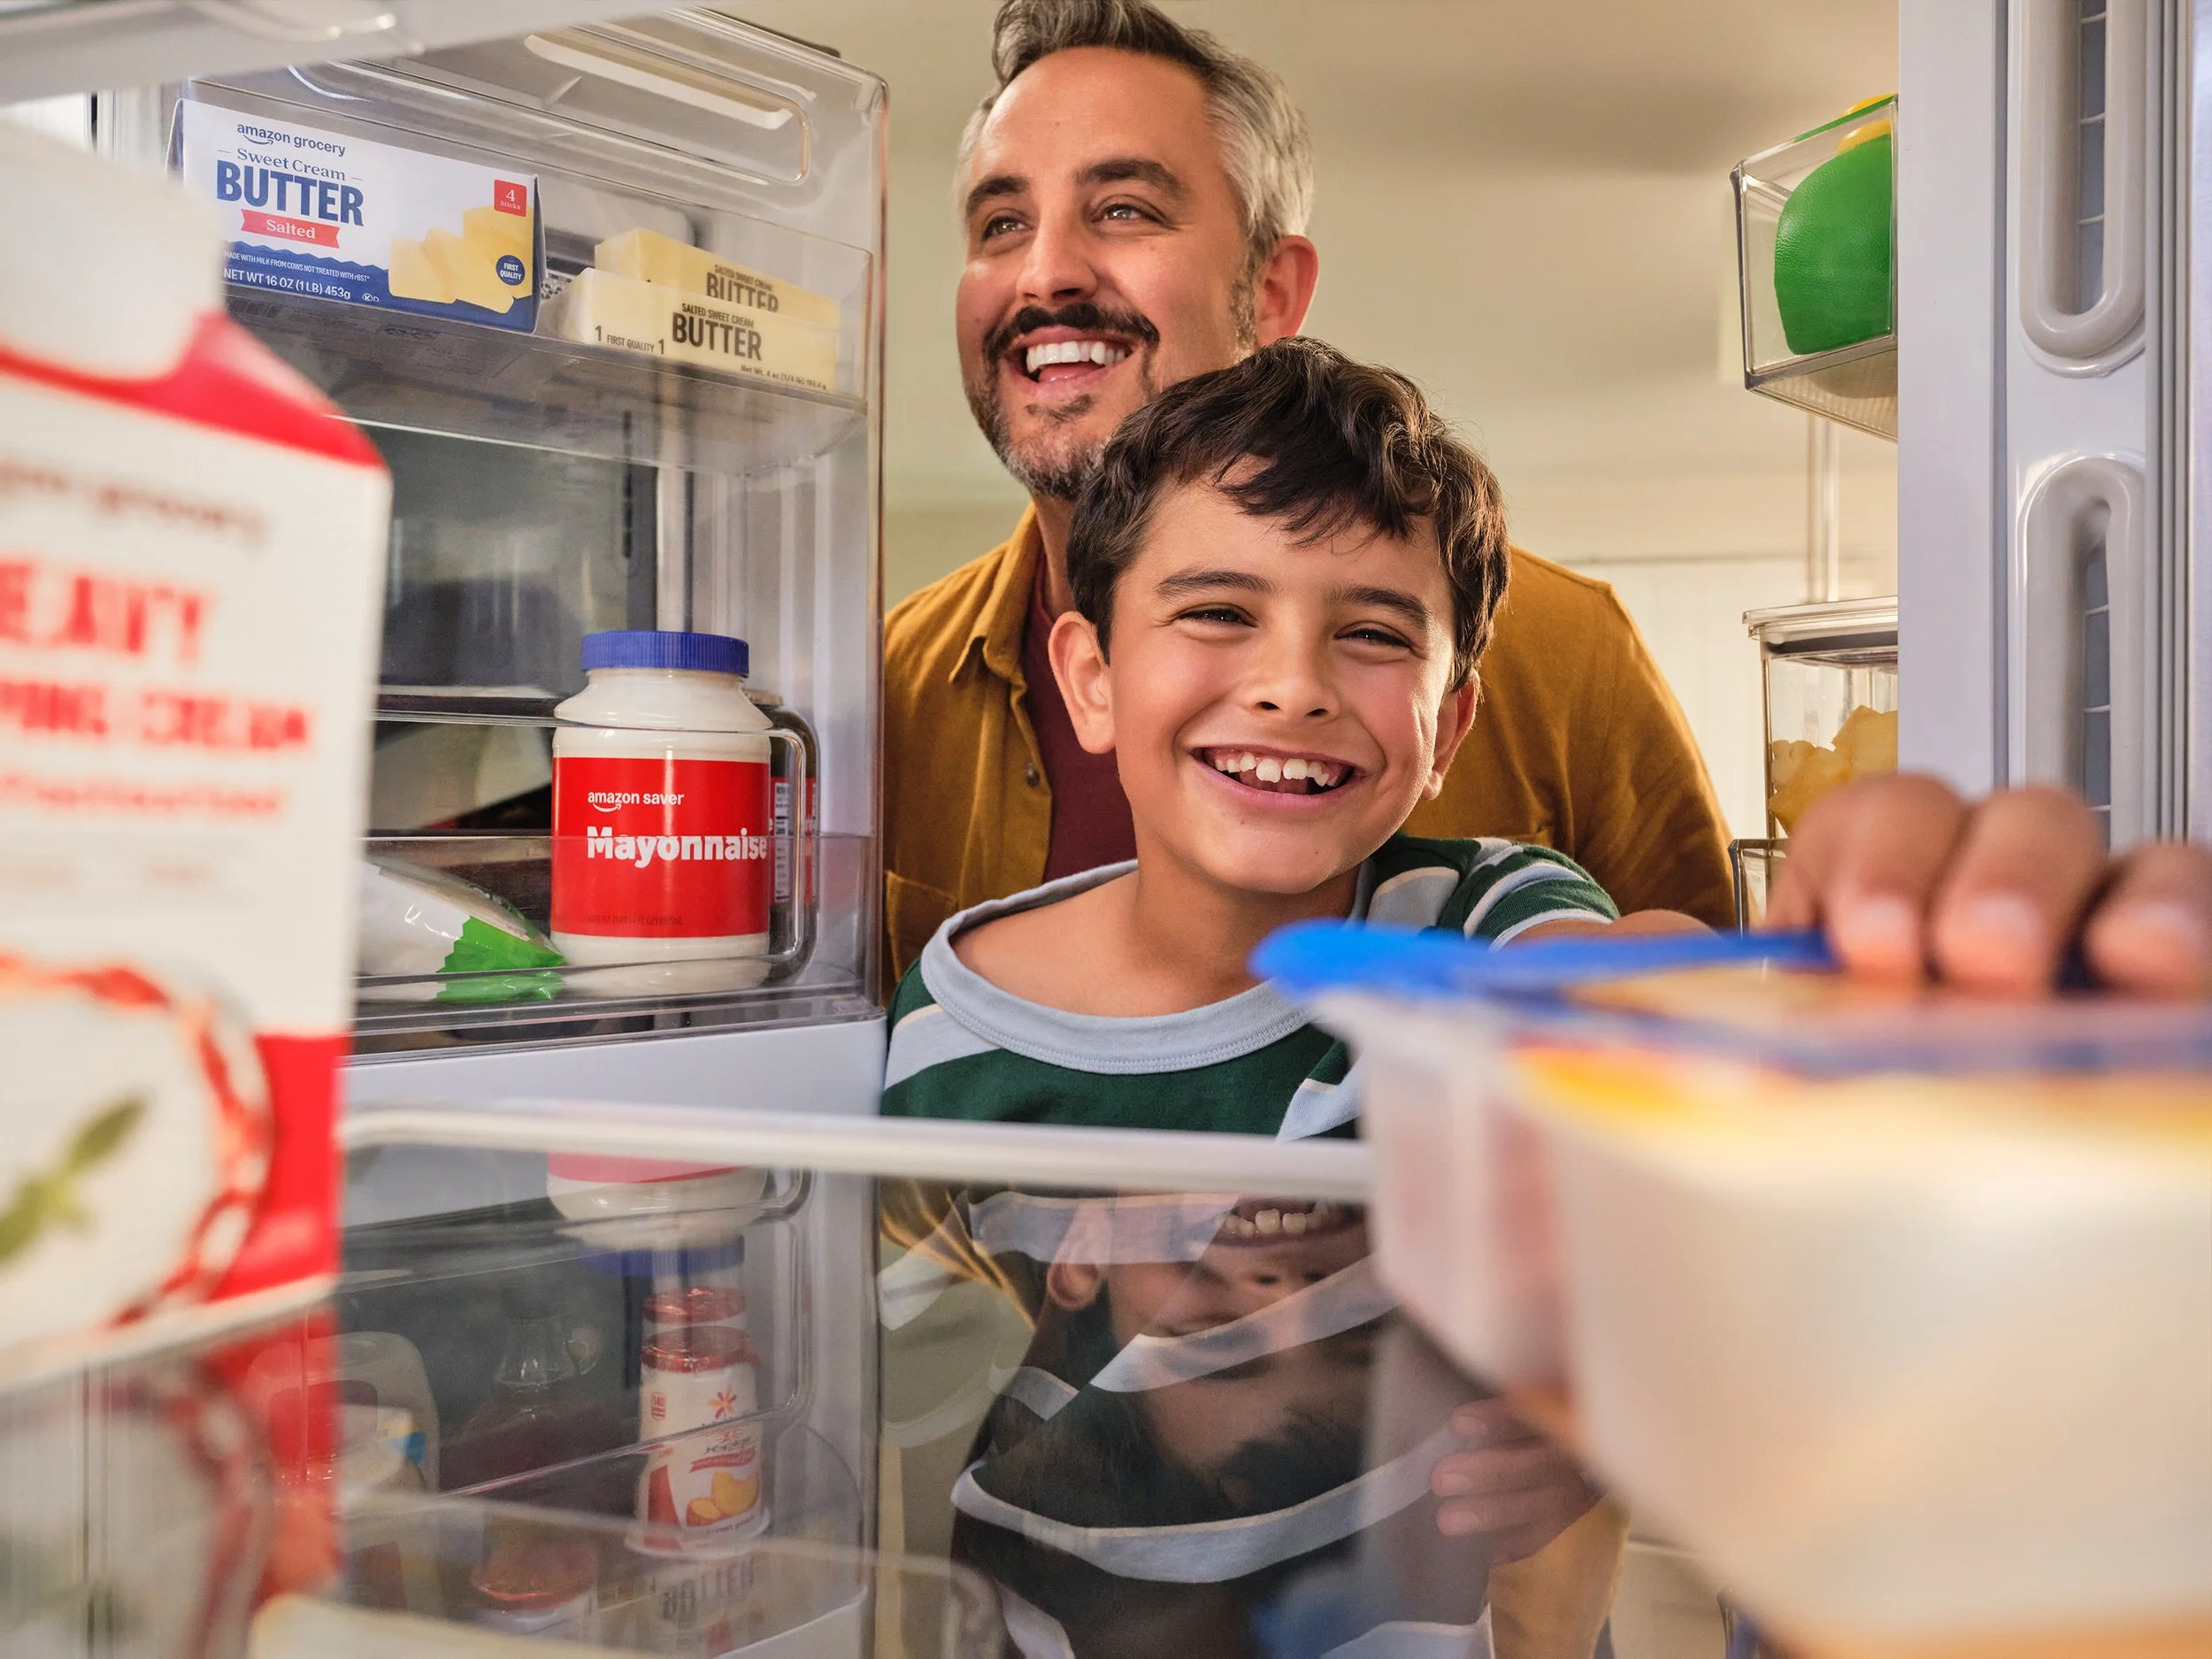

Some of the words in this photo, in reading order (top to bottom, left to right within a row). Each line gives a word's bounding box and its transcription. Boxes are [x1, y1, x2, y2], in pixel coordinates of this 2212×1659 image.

[237, 124, 291, 143] amazon
[294, 135, 346, 157] grocery
[237, 148, 288, 170] Sweet
[292, 159, 346, 181] Cream
[217, 159, 365, 227] BUTTER
[500, 200, 521, 210] Sticks
[505, 189, 516, 202] 4
[266, 219, 316, 239] Salted
[241, 254, 257, 263] WITH
[256, 257, 270, 265] MILK
[271, 258, 287, 268] FROM
[287, 262, 303, 271] COWS
[303, 265, 316, 273] NOT
[316, 266, 340, 278] TREATED
[340, 271, 354, 280] WITH
[500, 270, 522, 280] QUALITY
[503, 263, 518, 272] FIRST
[224, 267, 245, 281] NET
[246, 272, 265, 284] WT
[265, 275, 278, 287] 16
[279, 277, 294, 289] OZ
[306, 281, 323, 295] LB)
[325, 285, 351, 300] 453g
[681, 303, 706, 317] SALTED
[707, 310, 729, 322] SWEET
[732, 315, 754, 327] CREAM
[595, 325, 602, 342] 1
[606, 334, 626, 347] FIRST
[626, 339, 655, 352] QUALITY
[658, 339, 664, 354] 1
[672, 311, 762, 361] BUTTER
[588, 792, 640, 806] amazon
[643, 793, 684, 805] saver
[587, 826, 768, 869] Mayonnaise
